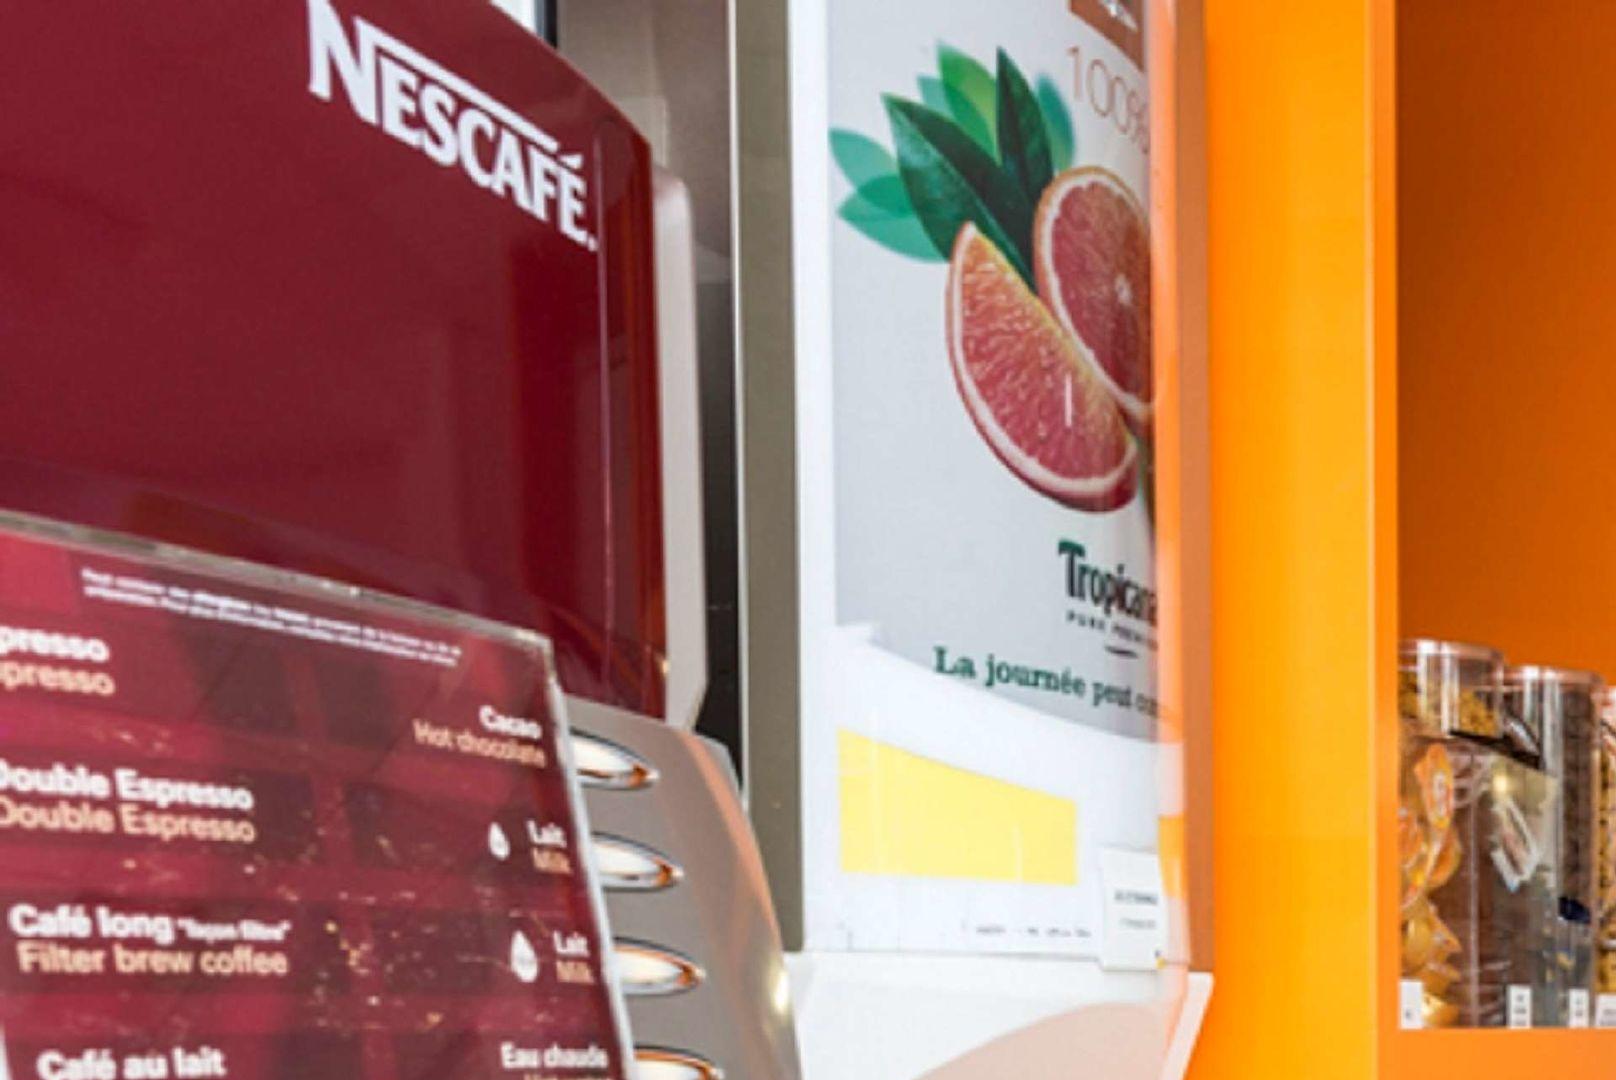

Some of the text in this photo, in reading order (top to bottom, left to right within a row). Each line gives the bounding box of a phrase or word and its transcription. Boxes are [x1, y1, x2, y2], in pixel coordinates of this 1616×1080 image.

[933, 645, 976, 682] La
[985, 653, 1086, 698] journée
[479, 704, 542, 740] Cacao
[412, 718, 546, 769] Hot chocolate
[116, 768, 254, 812] Espresso
[0, 794, 257, 845] Double Espresso
[527, 819, 567, 848] Lait
[9, 904, 91, 938] Café
[98, 905, 175, 944] long
[18, 943, 289, 976] Filter brew coffee
[553, 930, 591, 958] Lait
[124, 1056, 167, 1080] au
[174, 1047, 227, 1079] lait
[500, 1041, 541, 1070] Eau
